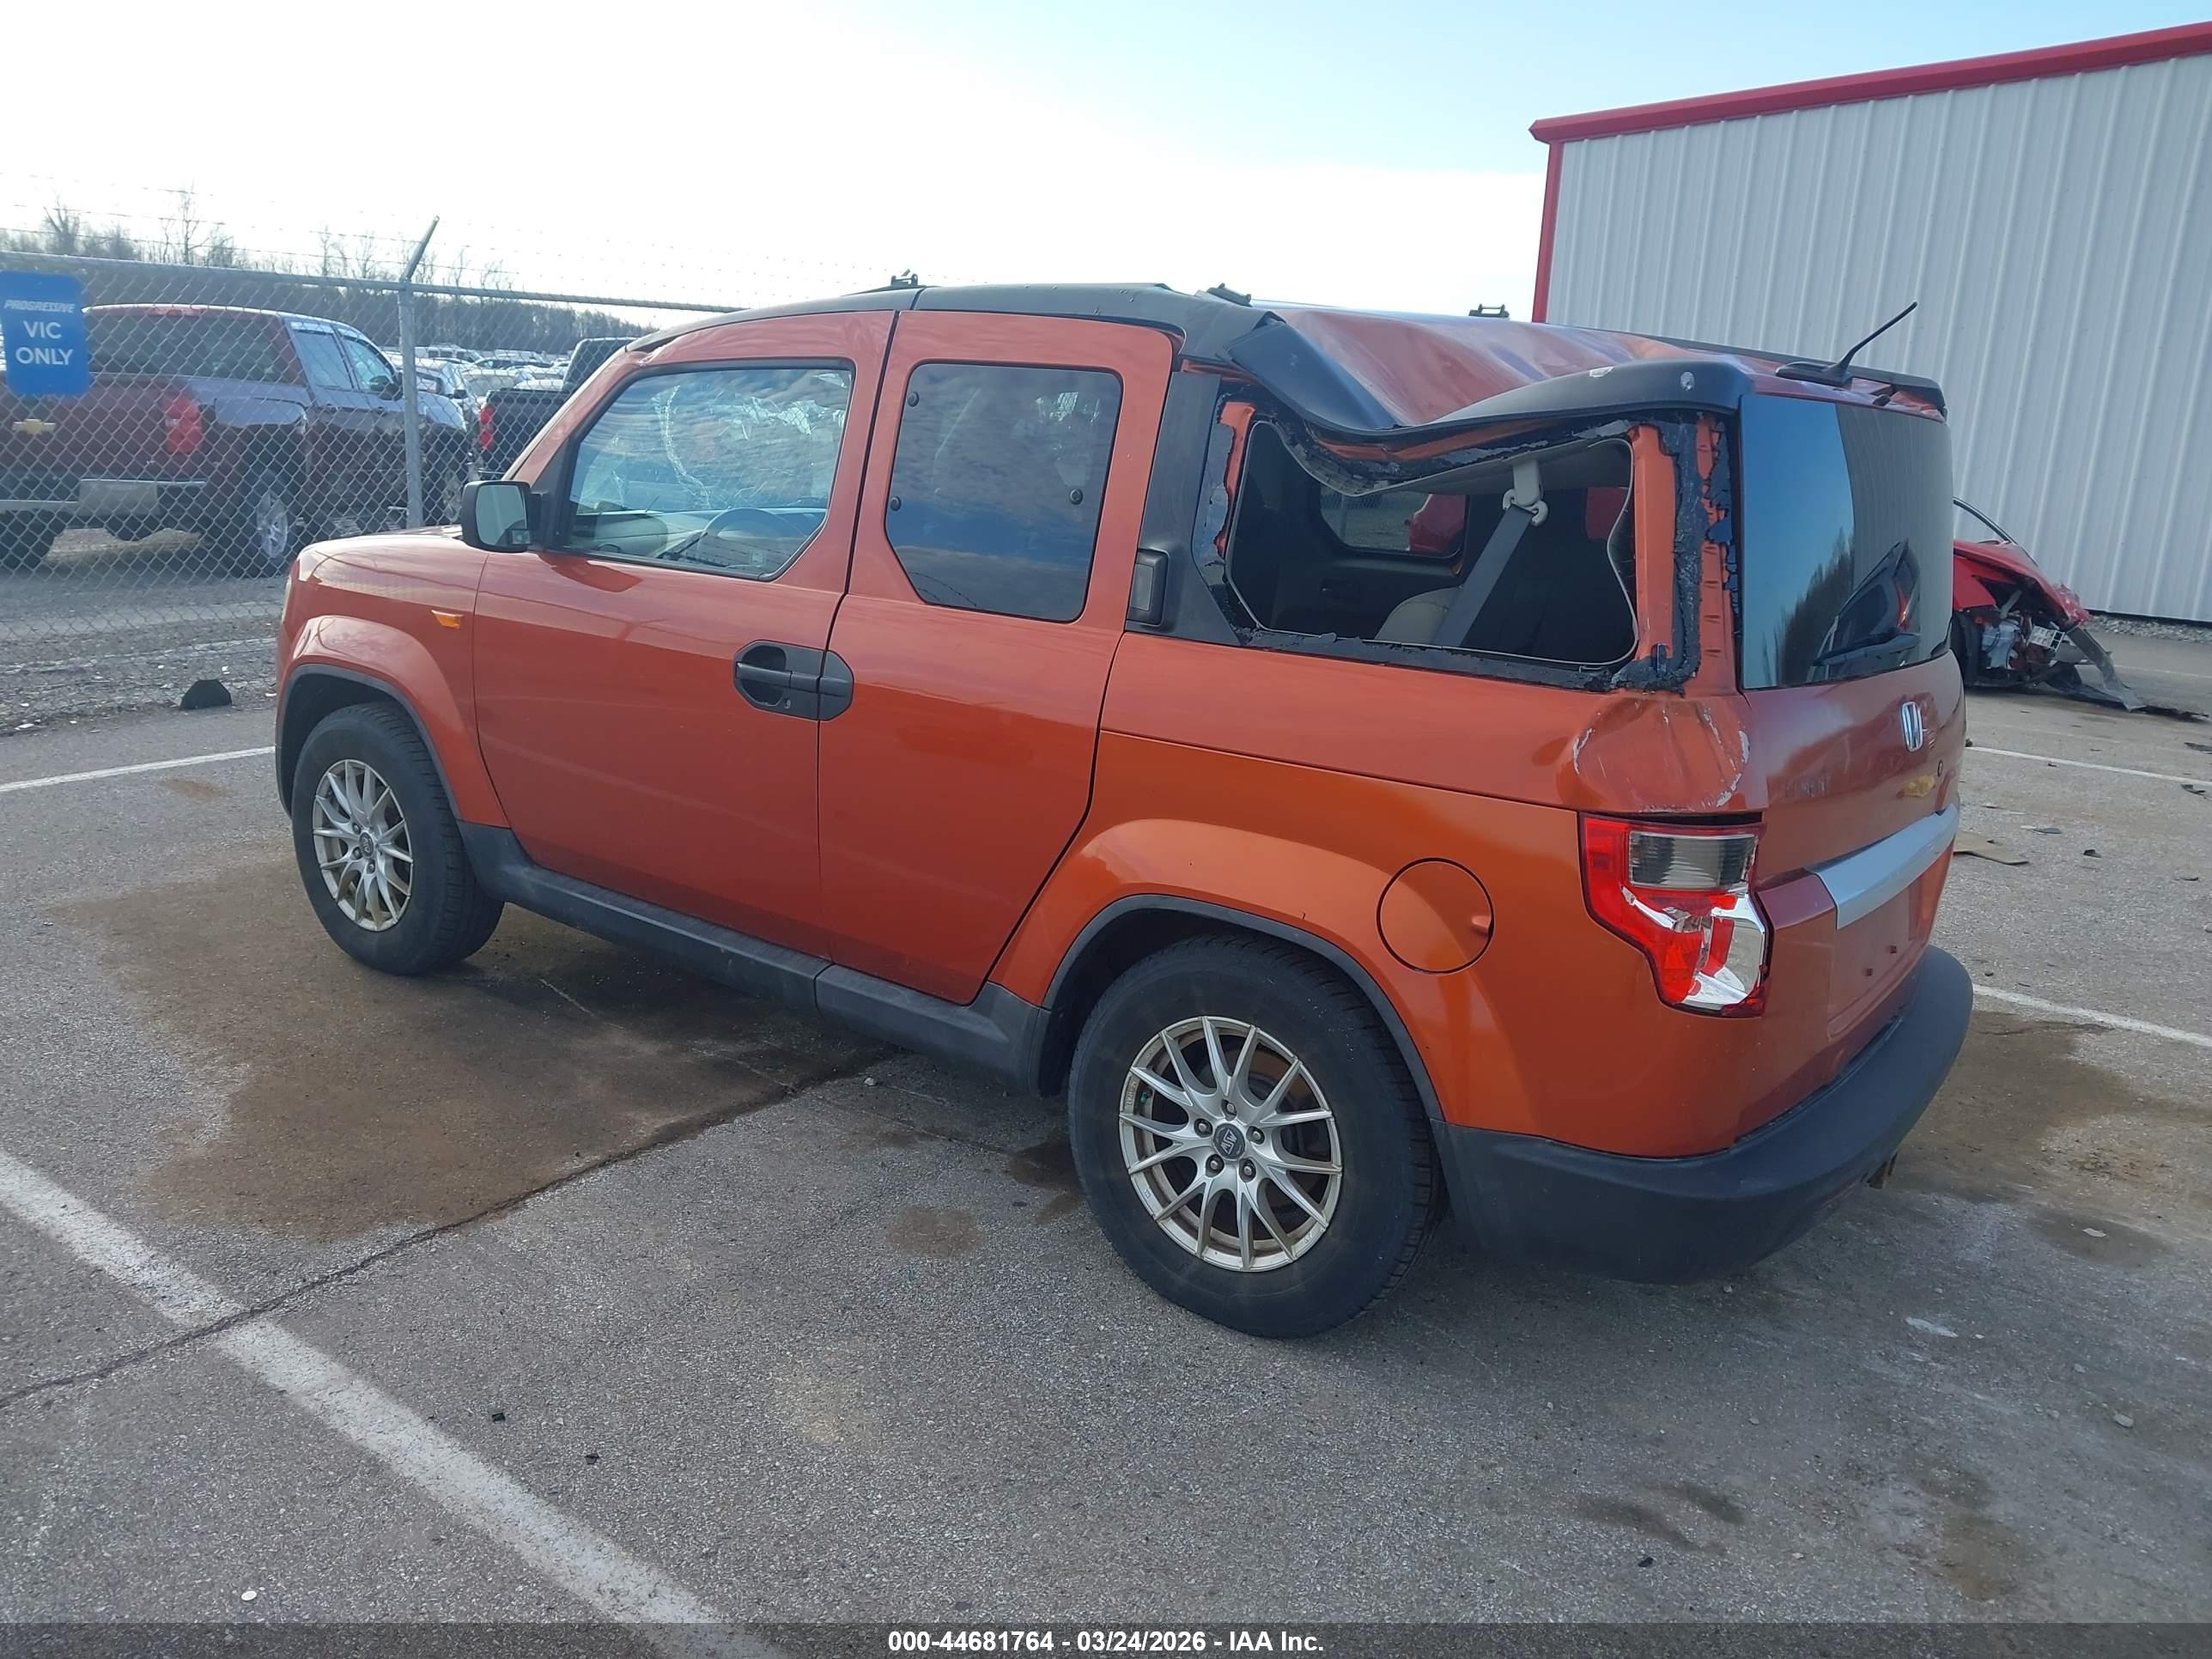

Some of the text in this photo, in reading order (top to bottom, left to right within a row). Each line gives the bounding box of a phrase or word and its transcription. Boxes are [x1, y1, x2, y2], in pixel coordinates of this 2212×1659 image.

[4, 300, 76, 313] PROGRESSIVE
[23, 320, 62, 339] VIC
[15, 347, 73, 365] ONLY
